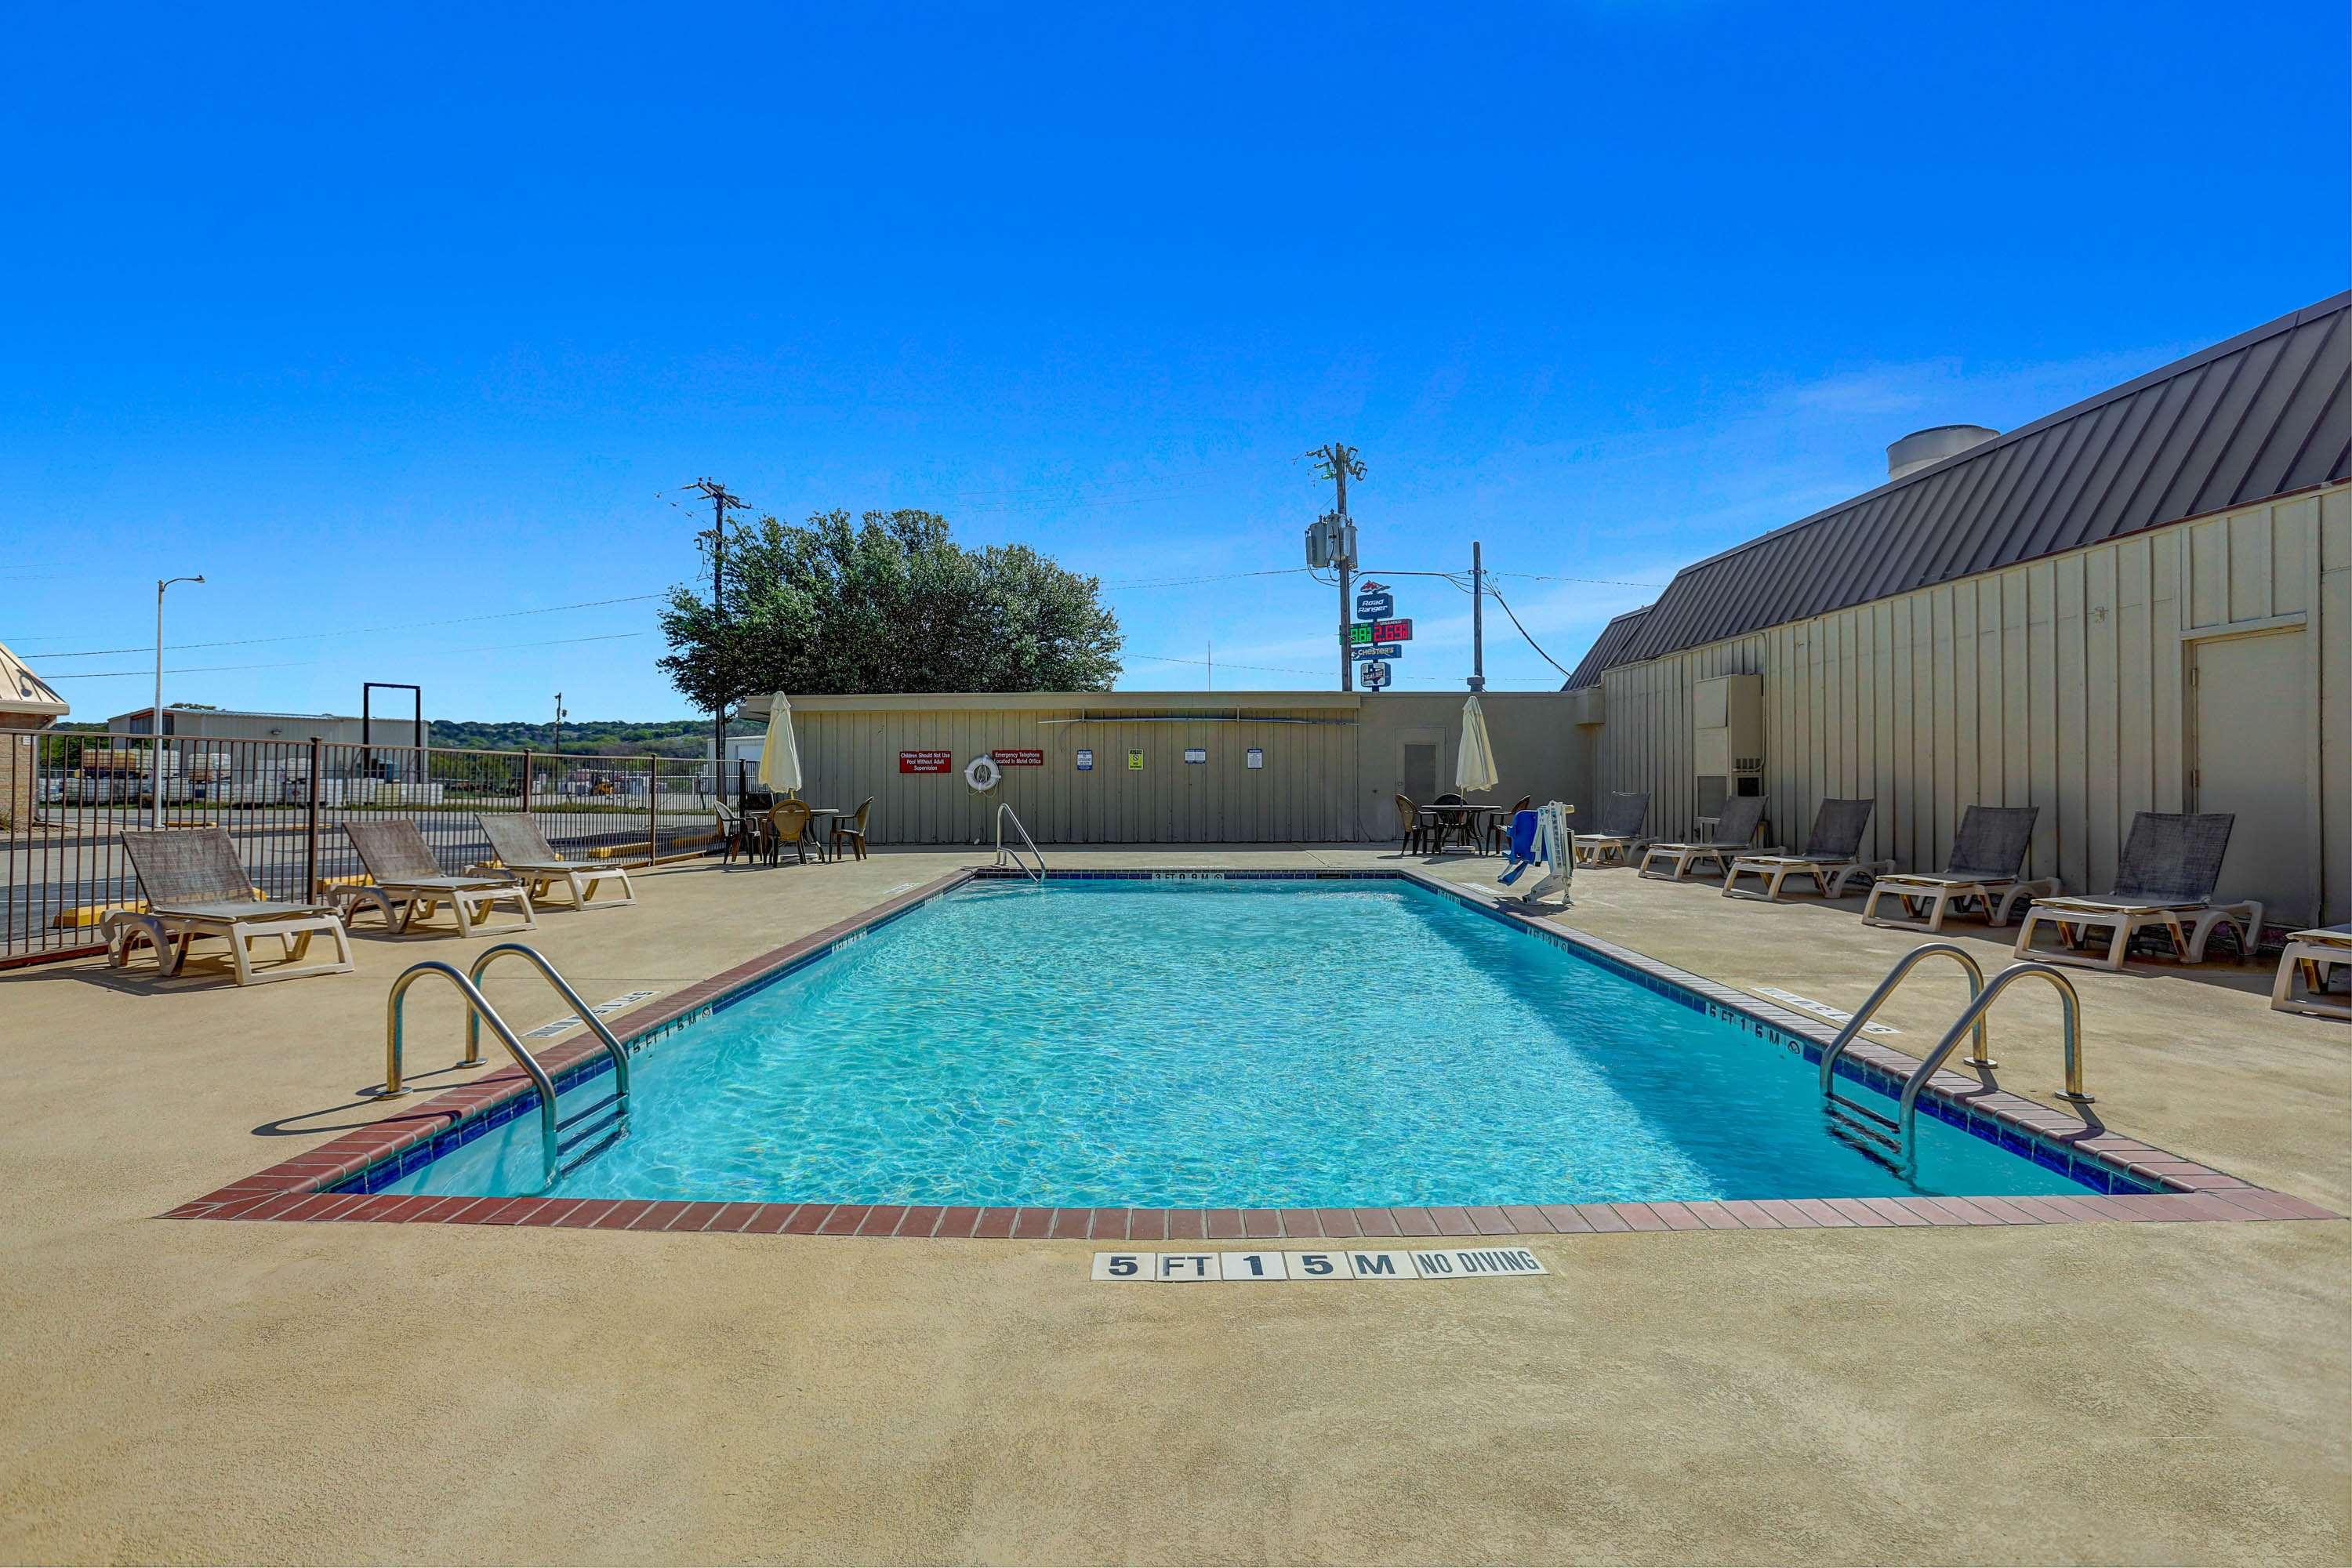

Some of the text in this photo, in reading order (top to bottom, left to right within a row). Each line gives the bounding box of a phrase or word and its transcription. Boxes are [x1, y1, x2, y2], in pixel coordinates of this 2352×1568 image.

[633, 1038, 641, 1054] 5
[645, 1030, 659, 1047] FT
[688, 1011, 697, 1026] M
[1710, 1004, 1717, 1018] 5
[1722, 1009, 1734, 1025] FT
[1740, 1018, 1745, 1031] 1
[1769, 1029, 1780, 1045] M
[1109, 1250, 1541, 1276] 5 FT 1 5 M NO DIVING
